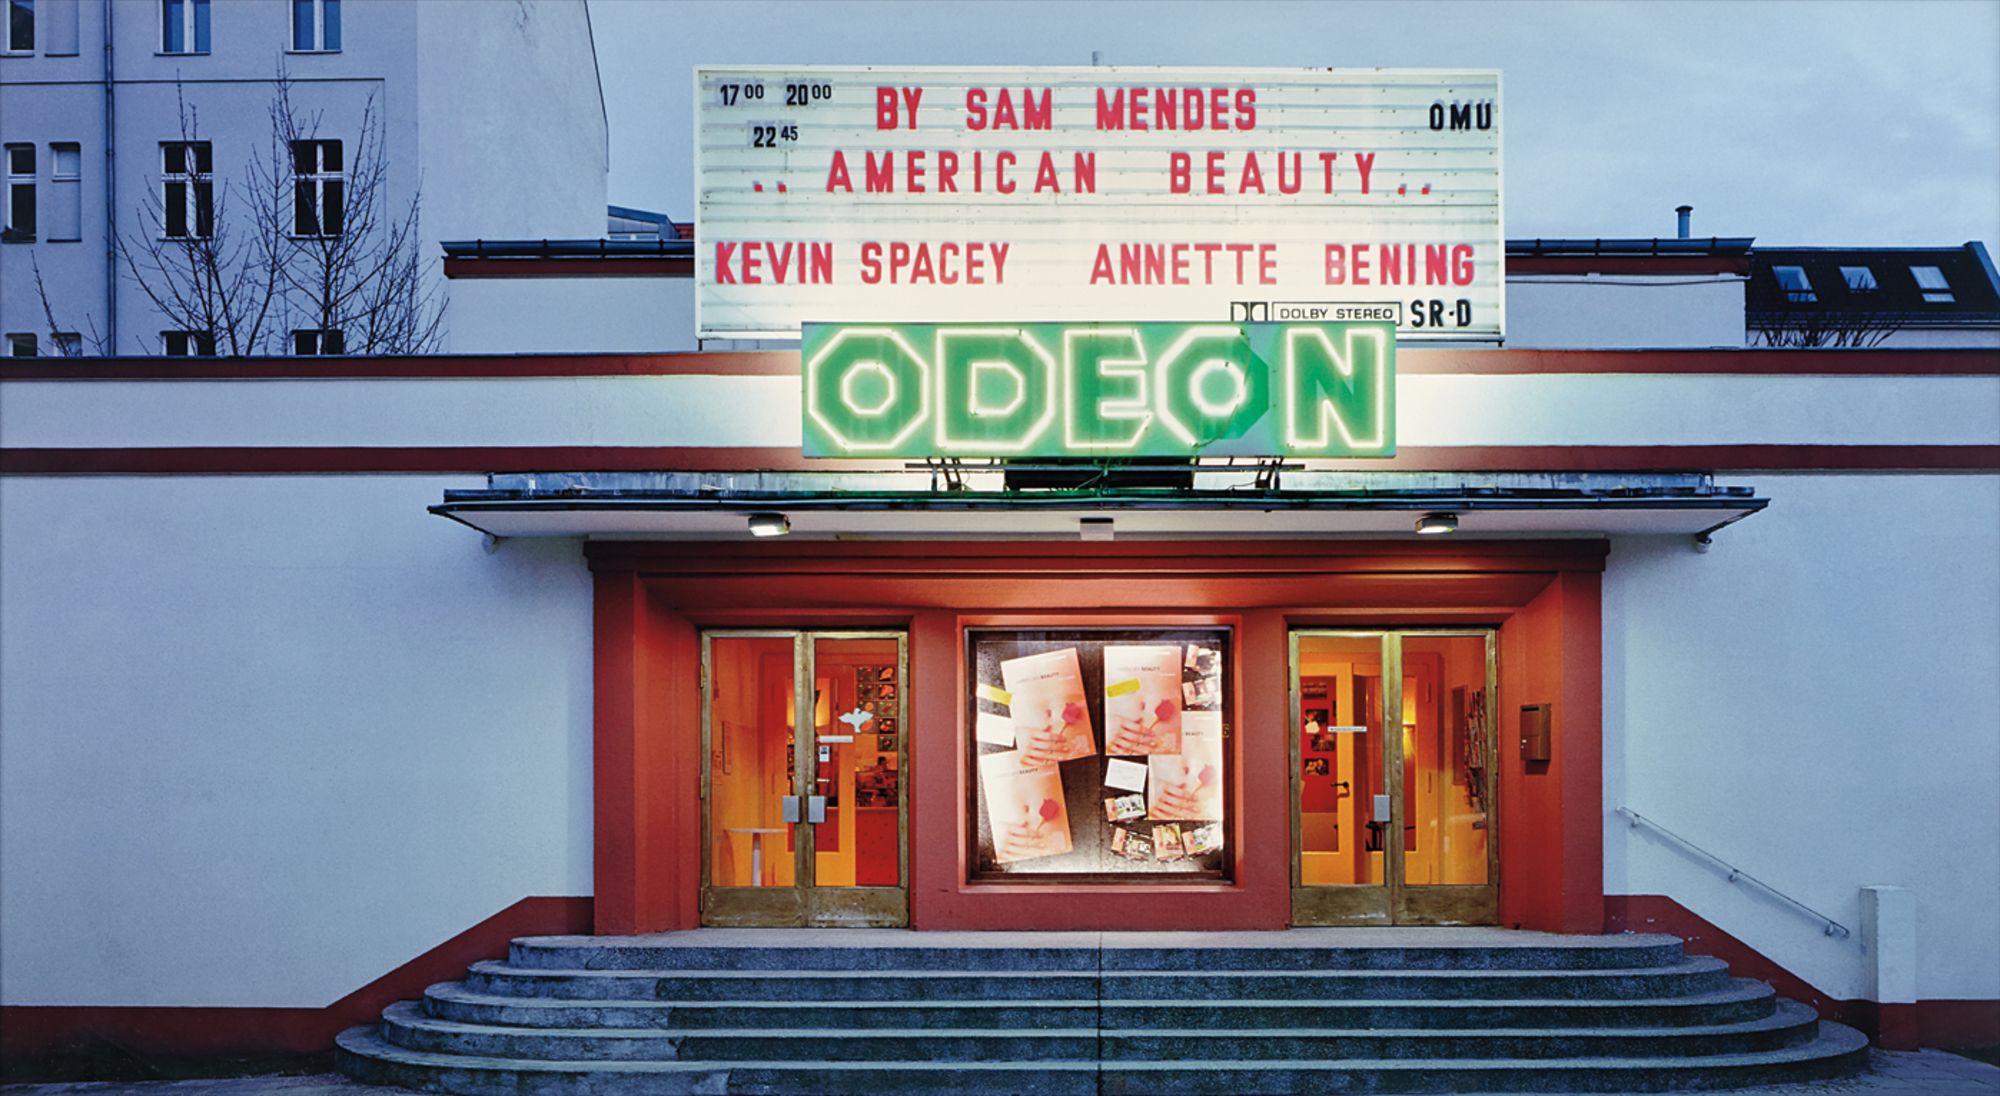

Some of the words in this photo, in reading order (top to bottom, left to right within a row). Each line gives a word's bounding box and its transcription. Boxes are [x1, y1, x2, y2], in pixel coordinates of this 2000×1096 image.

[877, 87, 922, 131] BY
[966, 88, 1052, 131] SAM
[1096, 87, 1257, 131] MENDES
[1429, 102, 1492, 131] OMU
[826, 151, 1096, 195] AMERICAN
[715, 241, 833, 285] KEVIN
[861, 242, 1010, 285] SPACEY
[1090, 243, 1278, 285] ANNETTE
[1324, 244, 1474, 287] BENING
[1280, 308, 1328, 319] DOLBY
[1336, 308, 1393, 319] STEREO
[808, 328, 1386, 450] ODEON
